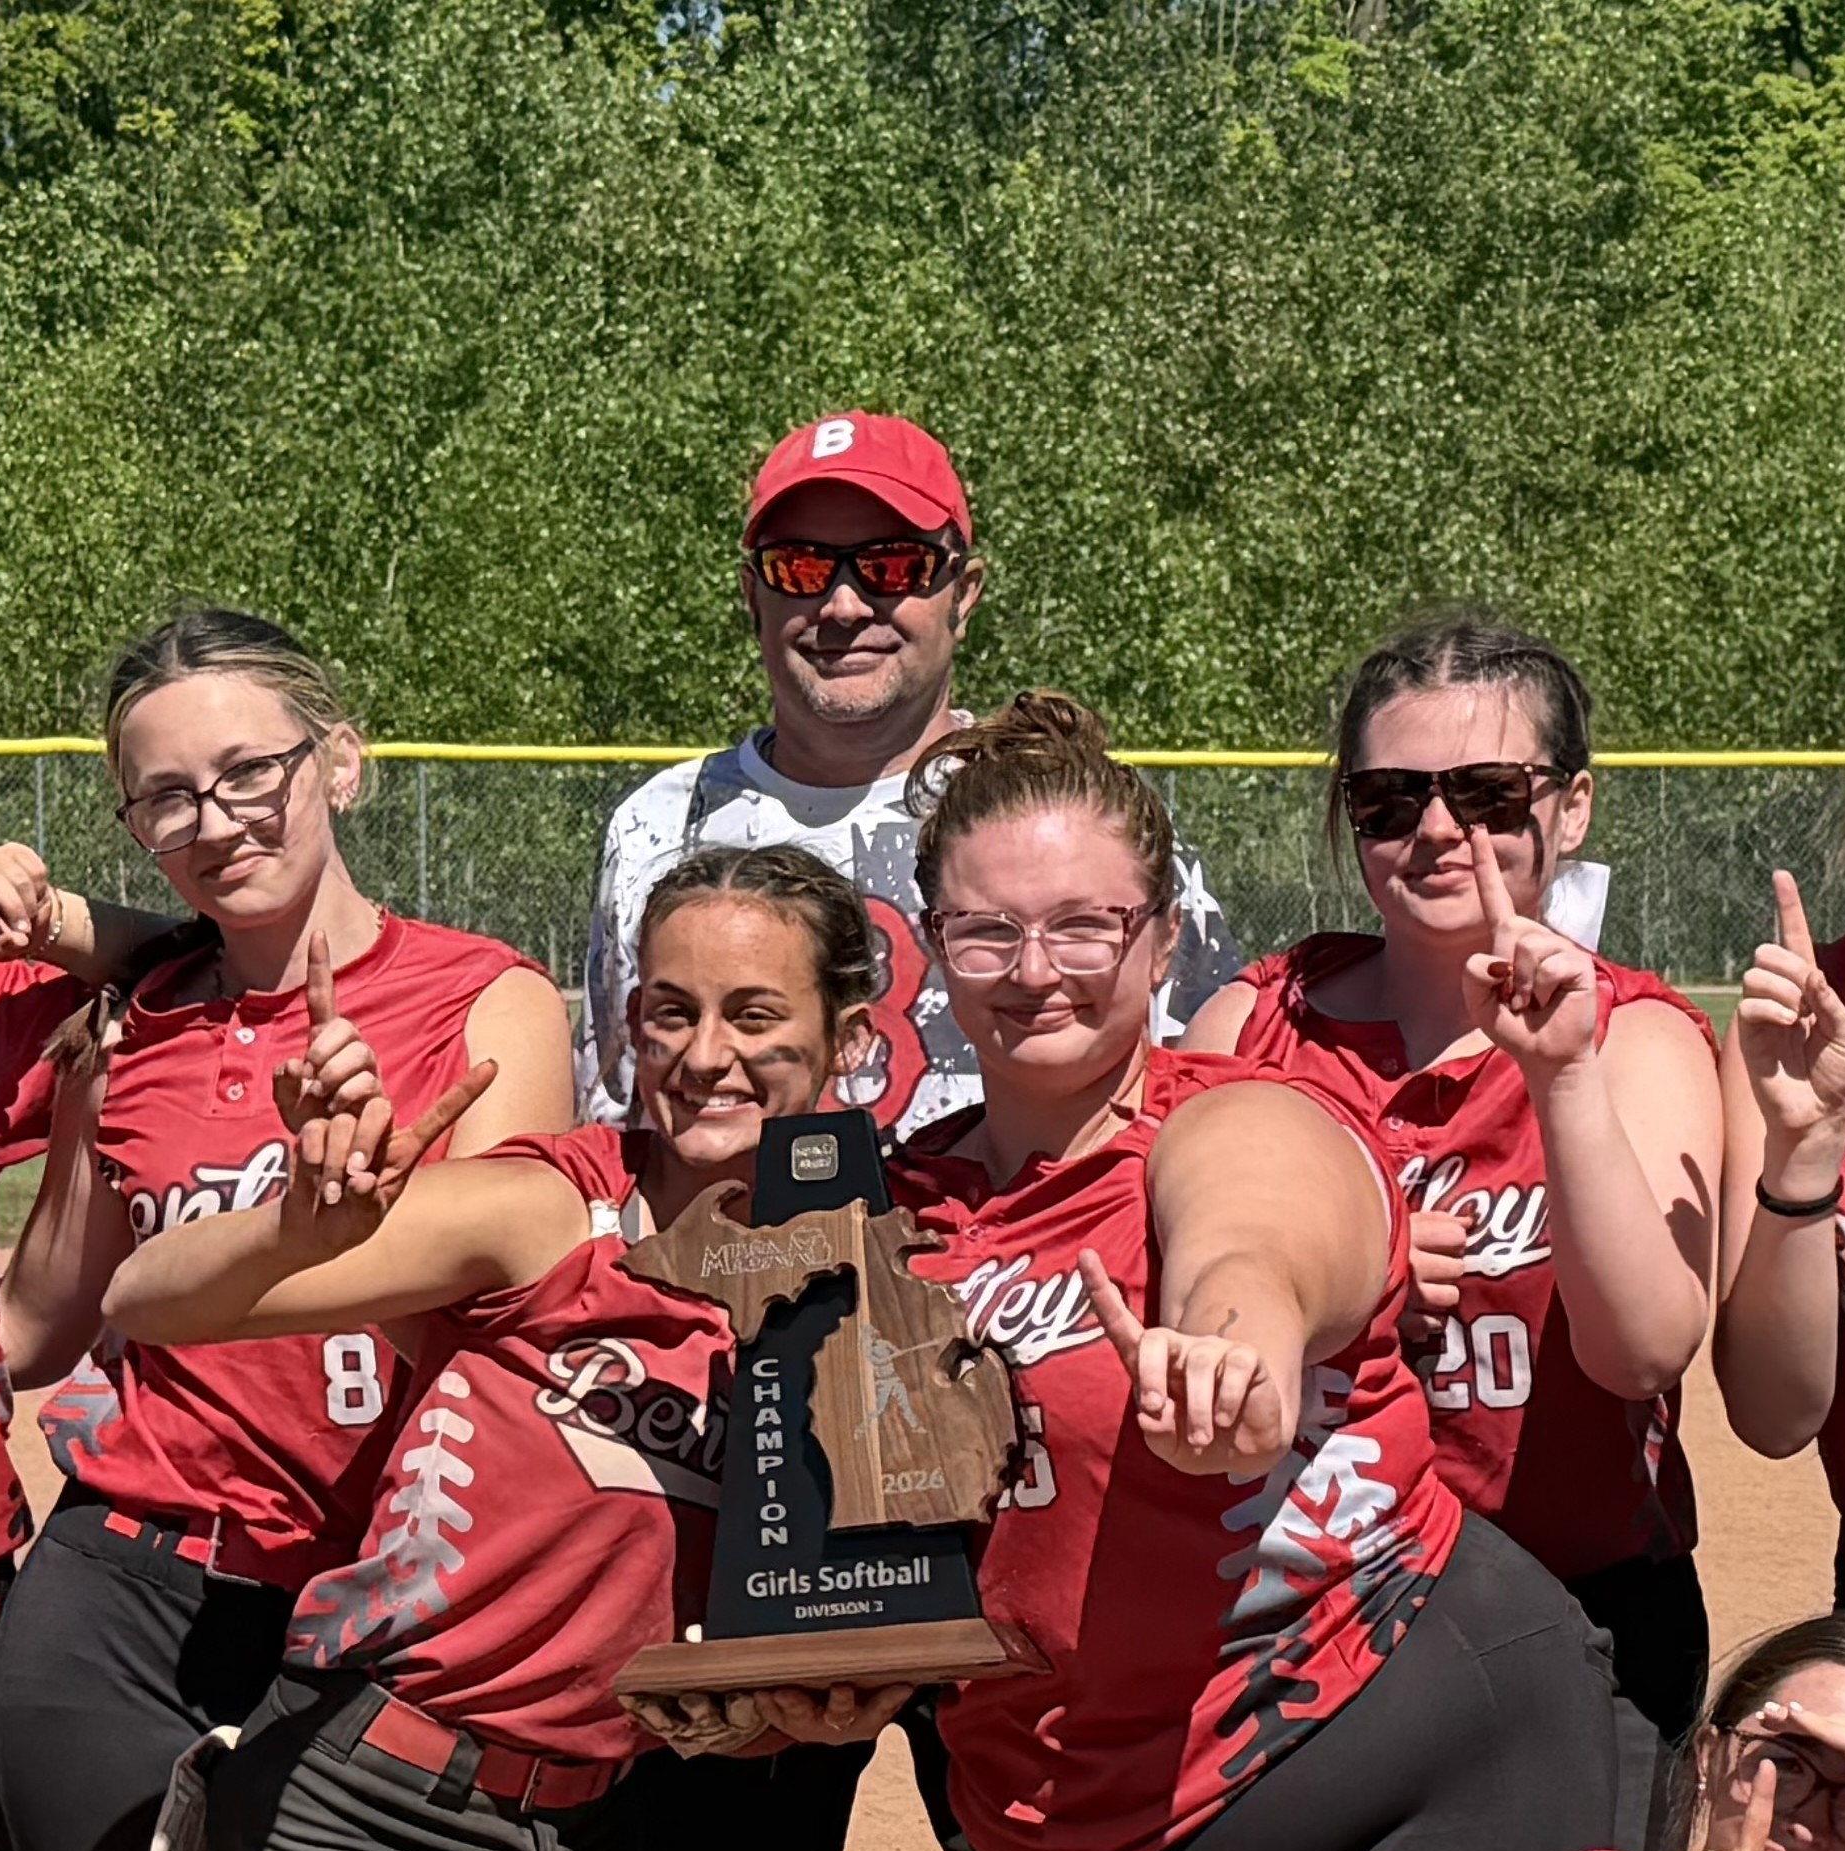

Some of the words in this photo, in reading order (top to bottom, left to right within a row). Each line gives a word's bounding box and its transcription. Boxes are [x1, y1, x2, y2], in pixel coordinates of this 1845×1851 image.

[811, 418, 856, 459] B
[322, 1333, 384, 1426] 8
[1423, 1314, 1532, 1409] 20
[751, 1358, 789, 1547] CHAMPION
[997, 1404, 1057, 1509] 5
[746, 1567, 812, 1598] Girls
[818, 1555, 931, 1592] Softball
[794, 1600, 870, 1619] DIVISION
